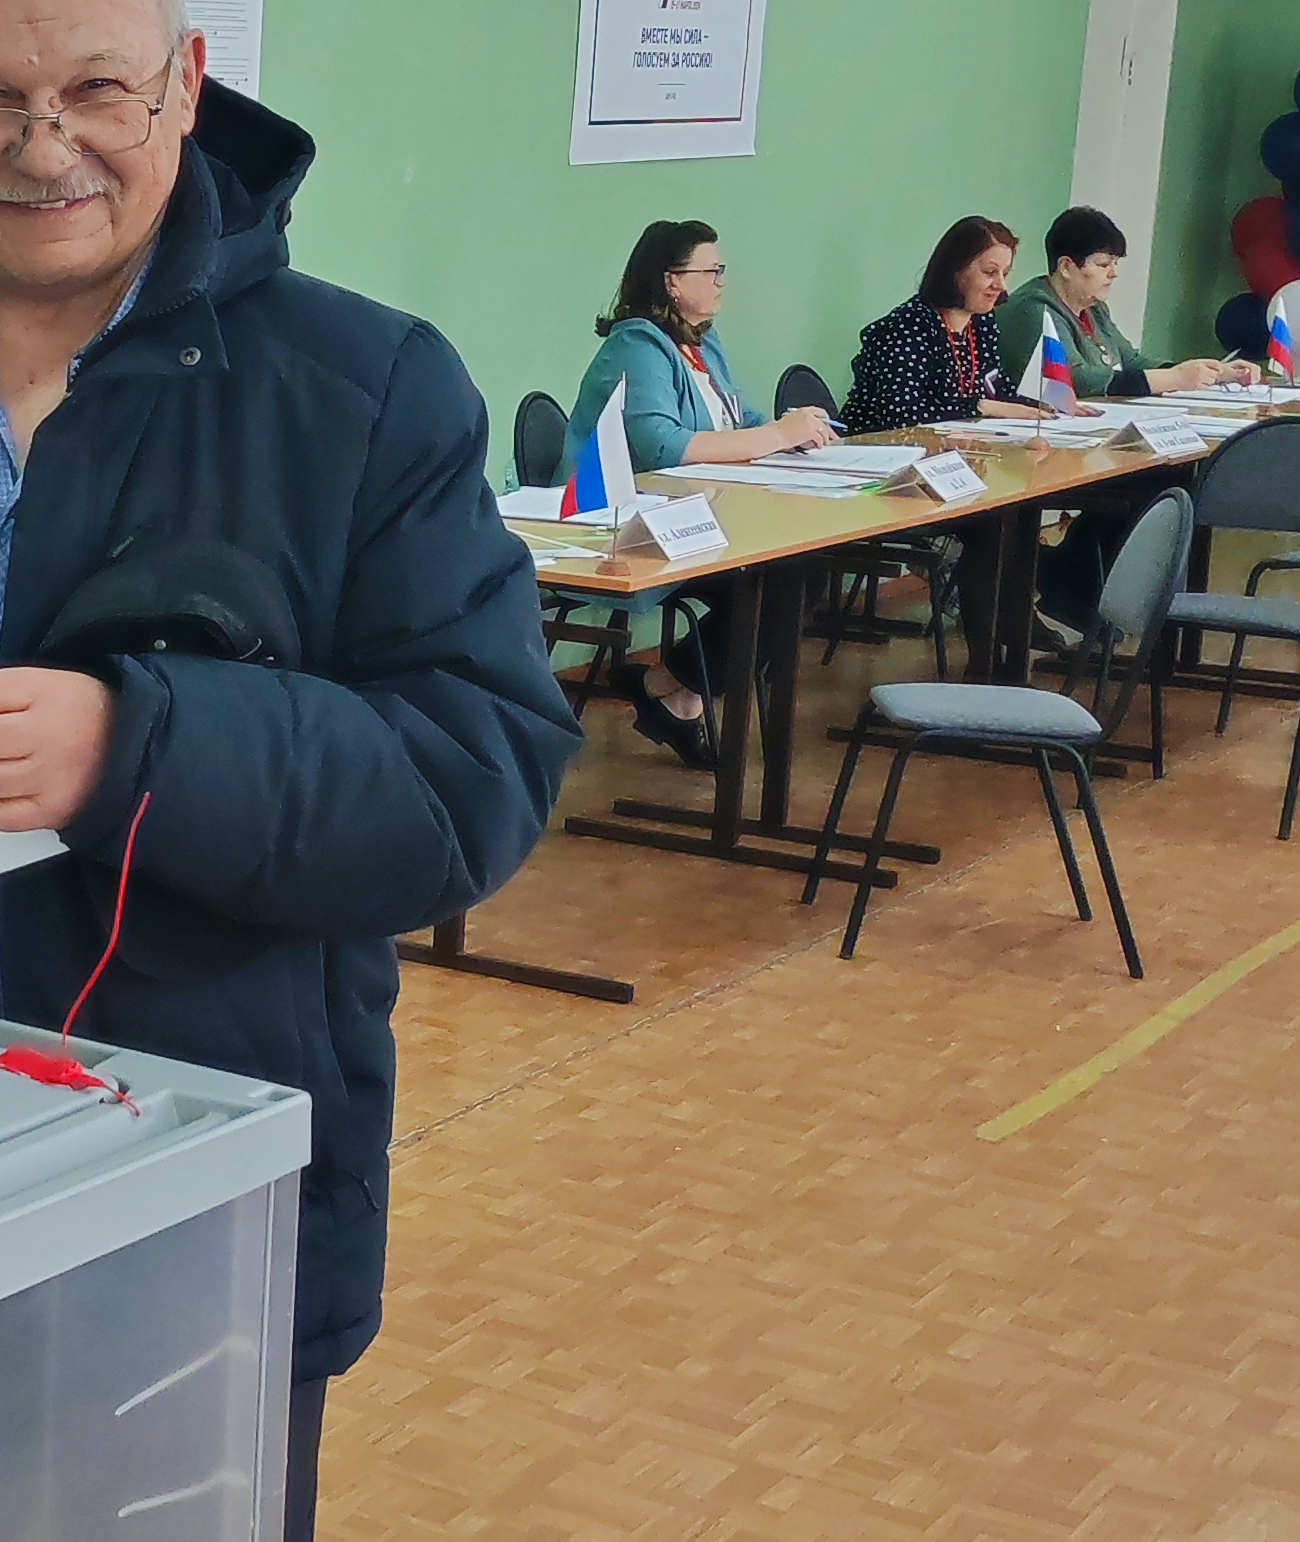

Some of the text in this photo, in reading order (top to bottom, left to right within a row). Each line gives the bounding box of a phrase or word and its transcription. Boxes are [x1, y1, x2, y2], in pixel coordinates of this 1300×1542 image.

[640, 27, 669, 44] ВМЕСТЕ
[669, 28, 683, 45] МЫ
[683, 28, 702, 45] СИЛА
[632, 51, 713, 68] ГОЛОСУЕМ ЗА РОССИЮ!
[657, 532, 672, 547] ул.
